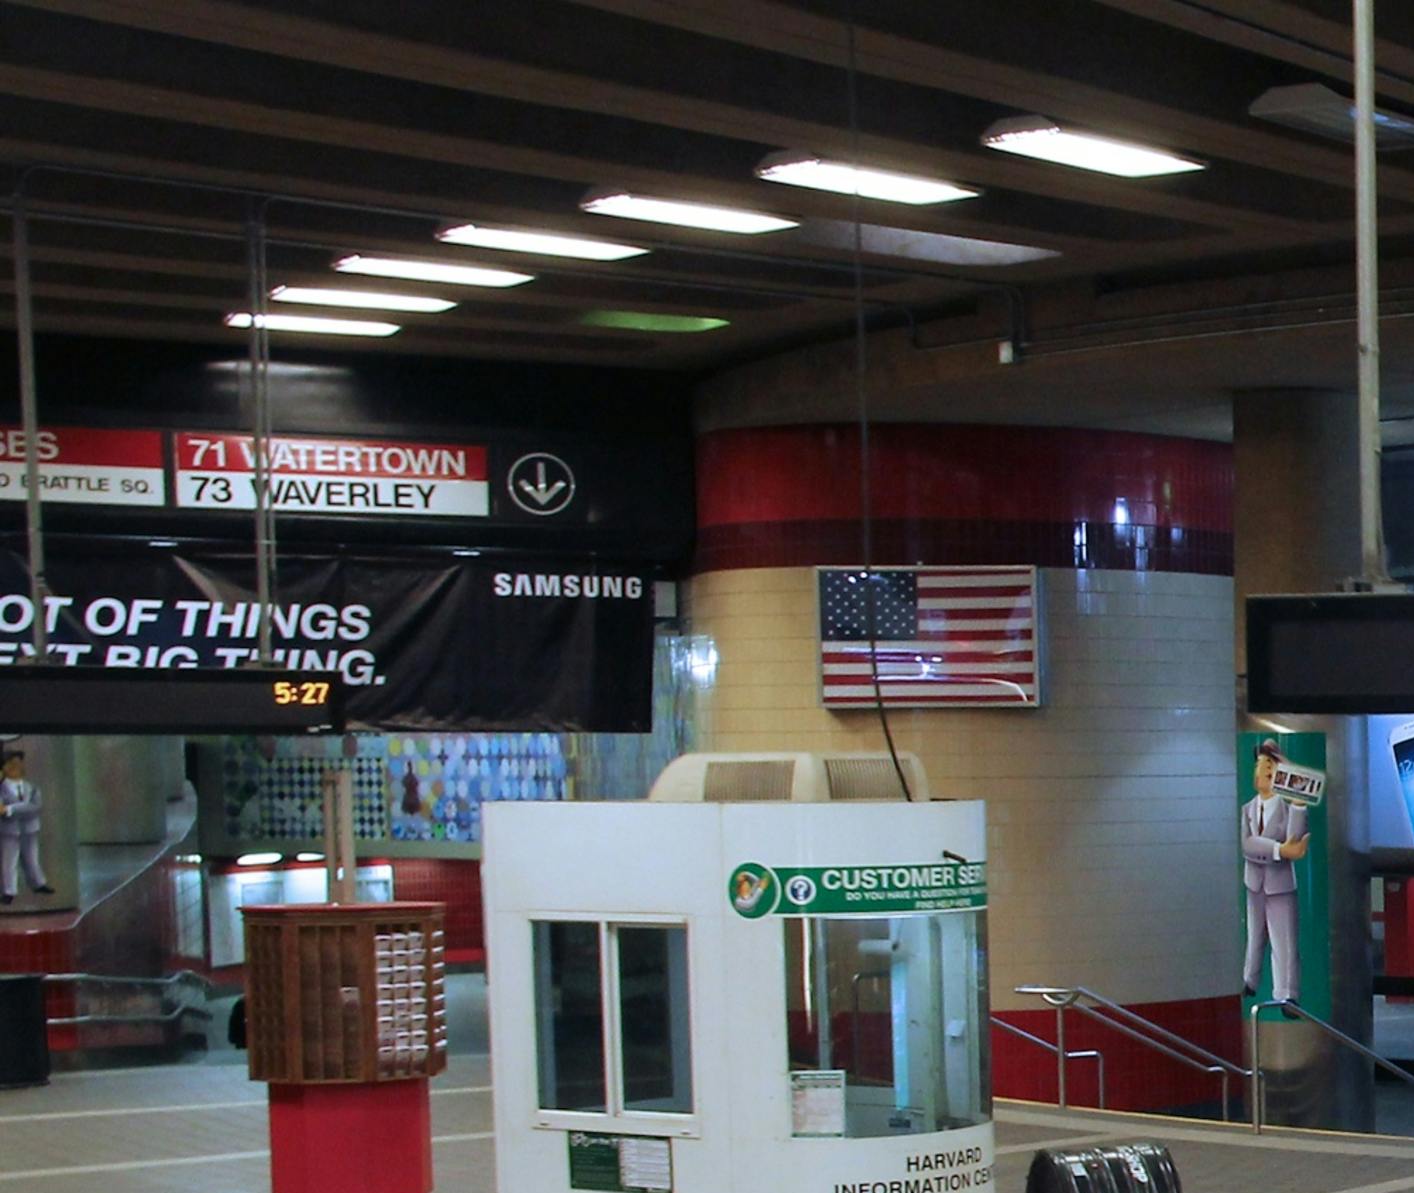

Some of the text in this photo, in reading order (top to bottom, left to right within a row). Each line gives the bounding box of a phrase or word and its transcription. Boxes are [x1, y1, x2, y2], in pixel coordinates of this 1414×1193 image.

[188, 439, 467, 477] 71 WATERTOWN
[120, 479, 154, 495] SQ.
[190, 476, 436, 508] 73 WAVERLEY
[494, 573, 643, 599] SAMSUNG
[0, 595, 372, 641] OT OF THINGS
[274, 682, 330, 705] 5:27
[821, 867, 952, 891] CUSTOMER
[906, 1147, 982, 1173] HARVARD
